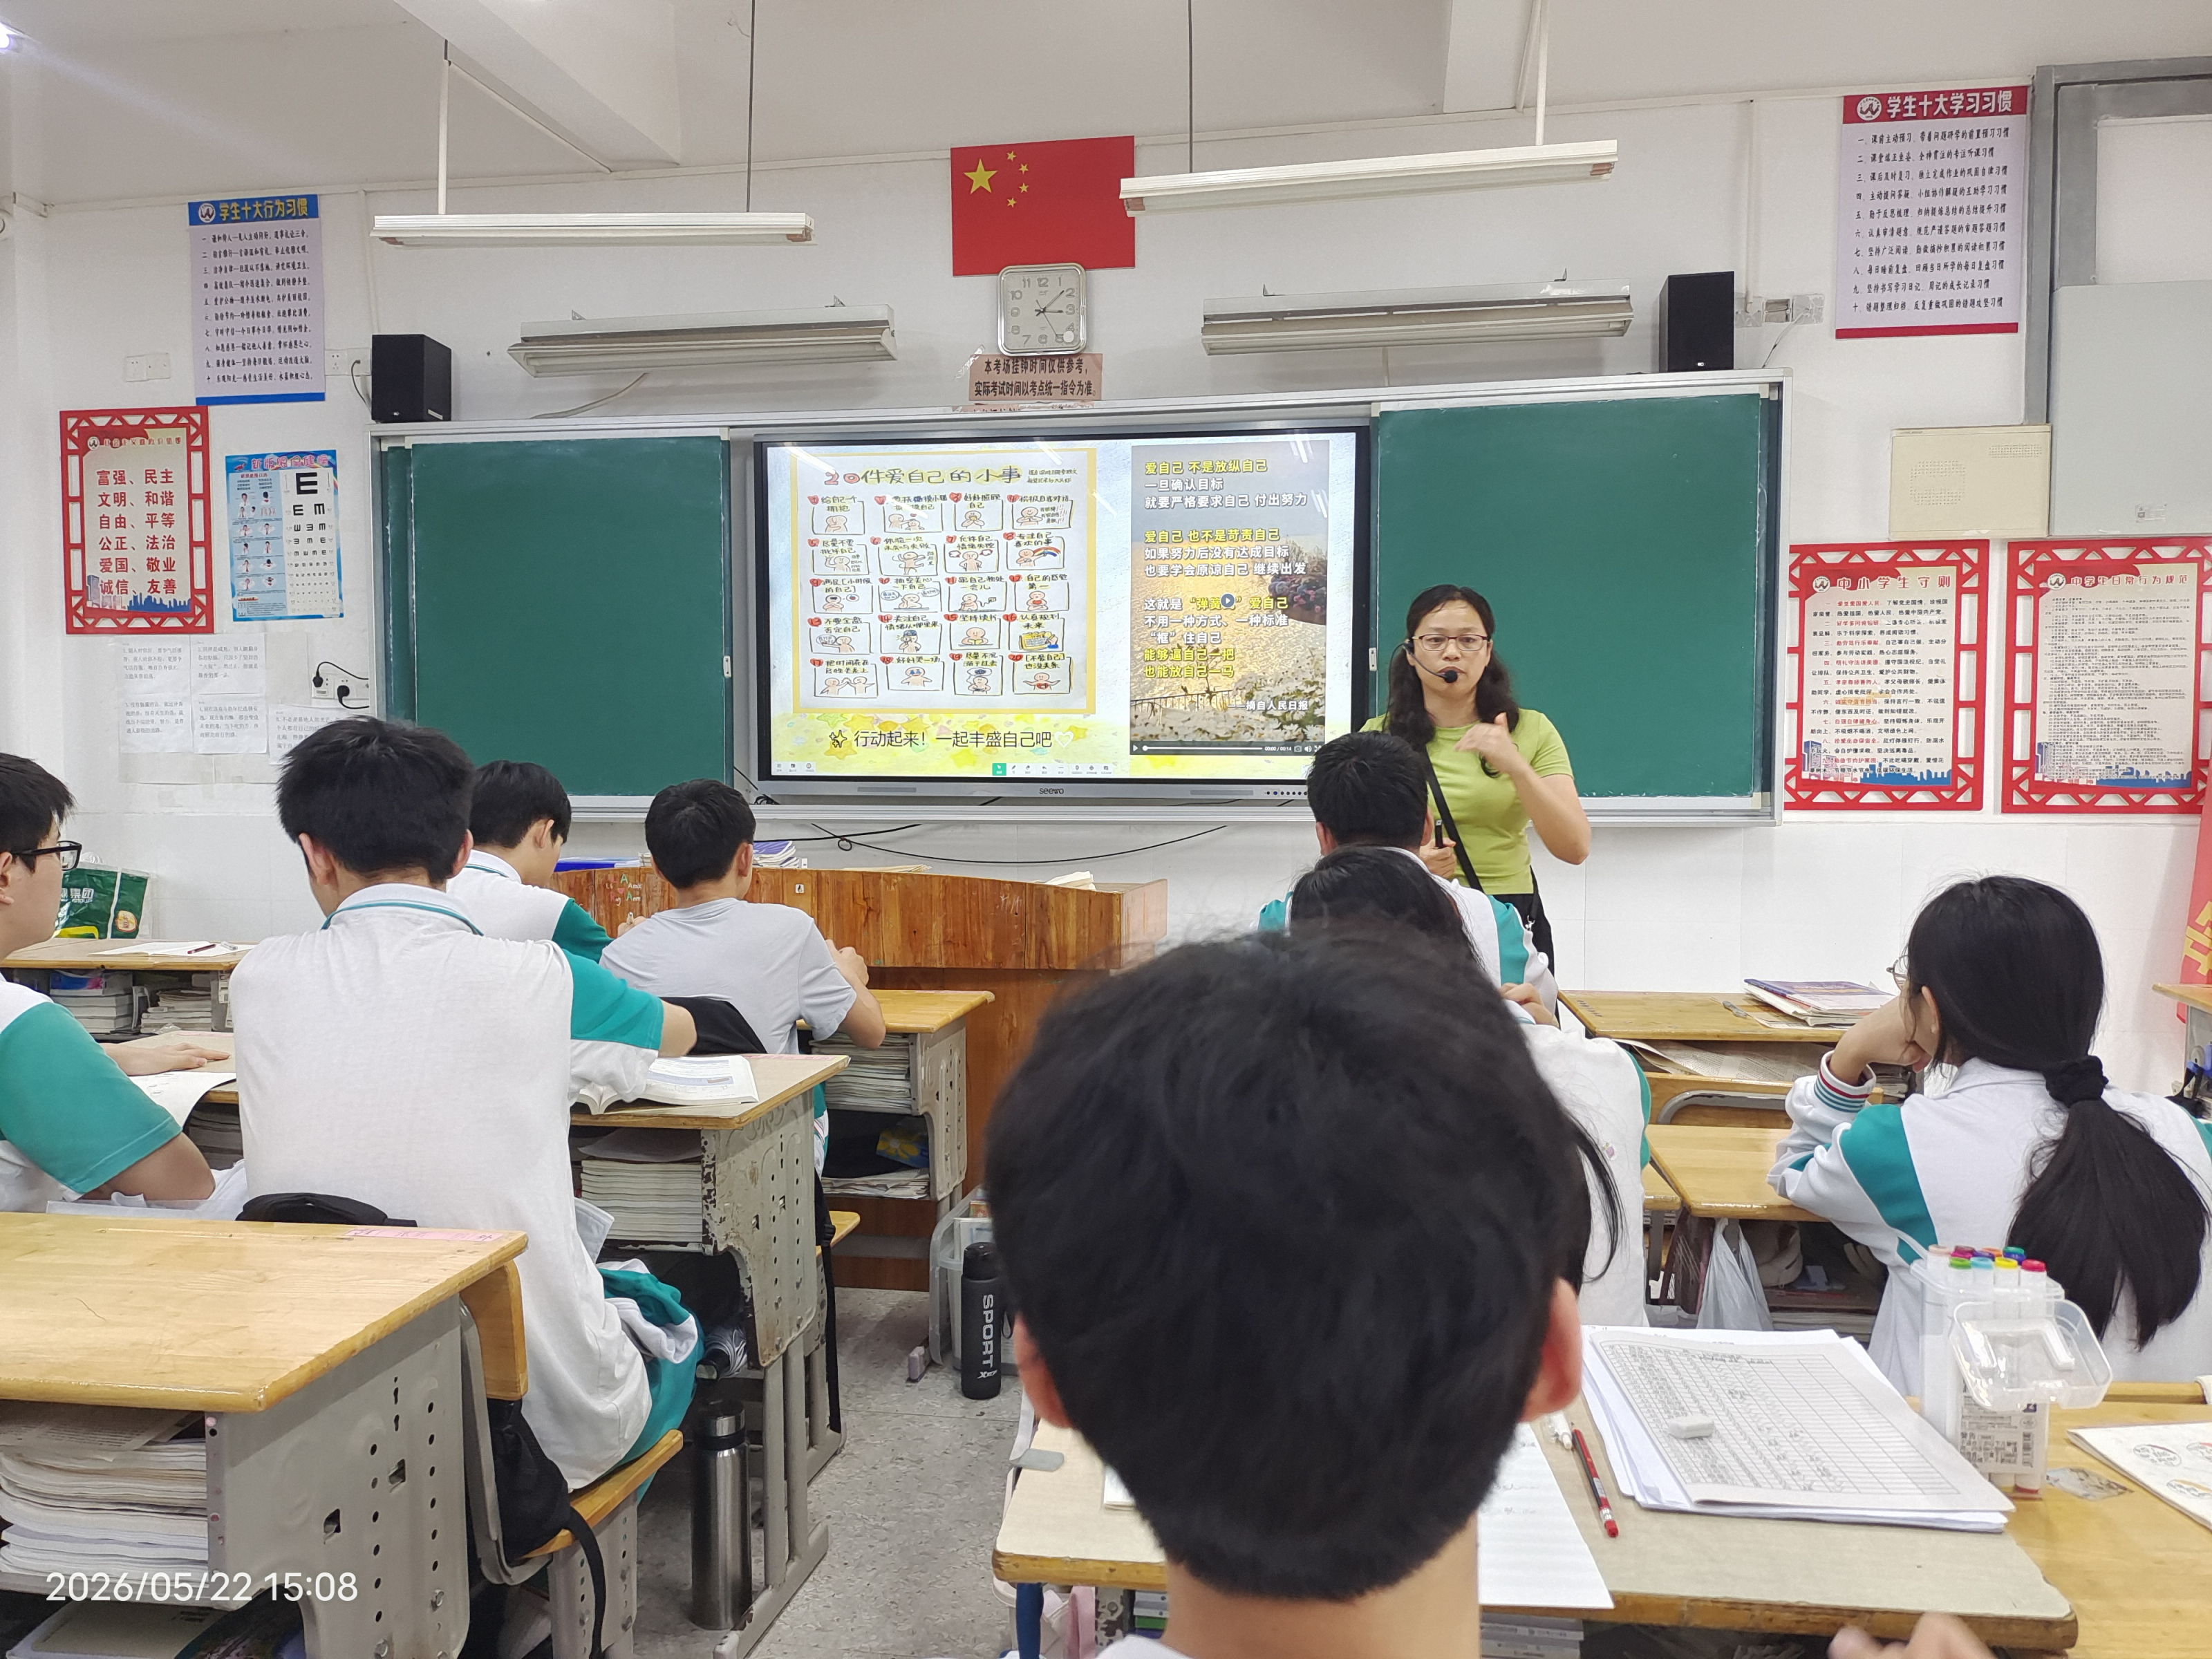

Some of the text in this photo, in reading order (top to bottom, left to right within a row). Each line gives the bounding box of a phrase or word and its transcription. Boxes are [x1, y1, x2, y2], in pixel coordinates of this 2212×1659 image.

[1887, 91, 2012, 118] 学生十大学习习惯
[220, 198, 308, 221] 学生十大行为习惯
[1022, 278, 1031, 288] 11
[1037, 278, 1049, 287] 12
[1058, 277, 1062, 286] 1
[1011, 290, 1022, 300] 10
[1066, 288, 1075, 297] 2
[1011, 308, 1020, 317] 9
[1066, 304, 1075, 315] 3
[1011, 326, 1020, 335] 8
[1066, 324, 1075, 332] 4
[1022, 335, 1031, 345] 7
[1038, 335, 1047, 344] 6
[1056, 334, 1064, 343] 5
[984, 359, 1087, 375] 本考场挂钟时间仅供参考，
[975, 380, 1096, 396] 实际考试时间以考点统一指令为准。
[1145, 460, 1267, 475] 爱自己 不是放纵自己
[1145, 478, 1223, 492] 一旦确认目标
[1145, 493, 1307, 509] 就要严格要求自己 付出努力
[1145, 528, 1280, 543] 爱自己 也不是苛责自己
[1145, 546, 1289, 561] 如果努力后没有达成目标
[1145, 563, 1306, 577] 也要学会原谅自己 继续出发
[1837, 575, 1951, 590] 中小学生守则
[2071, 575, 2188, 586] 中学生日常行为规范
[1144, 648, 1234, 662] 能够逼自己一把
[1144, 666, 1234, 678] 也能放自己一马
[982, 1294, 994, 1368] SPORT
